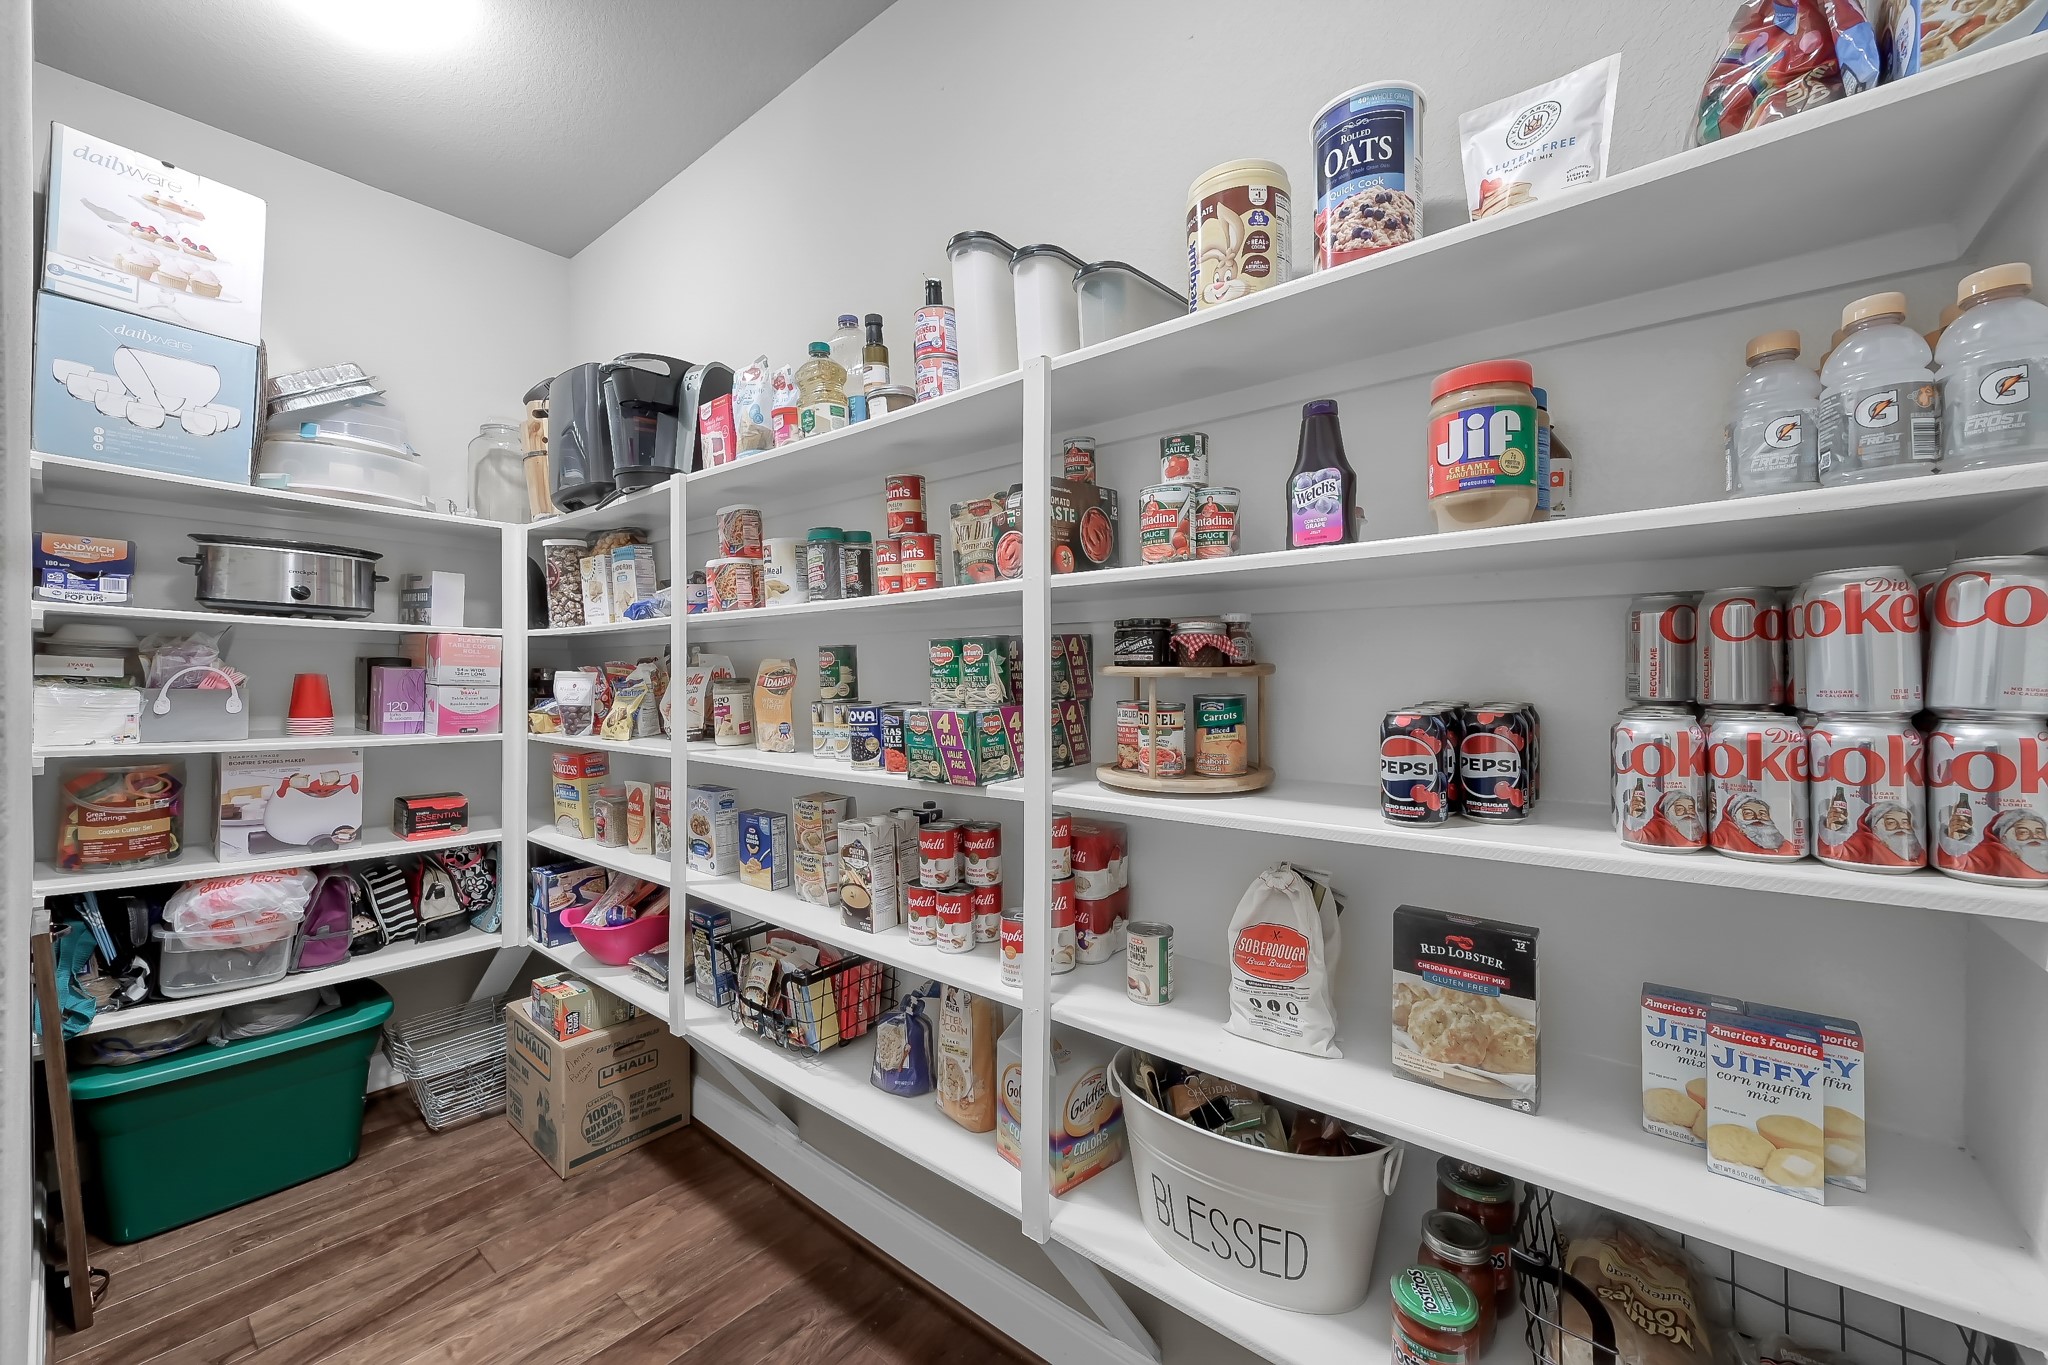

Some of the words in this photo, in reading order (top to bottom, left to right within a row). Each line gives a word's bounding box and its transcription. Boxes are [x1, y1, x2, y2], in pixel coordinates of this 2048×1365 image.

[1511, 114, 1527, 135] KING
[1530, 104, 1558, 114] ARTHUR
[1340, 129, 1371, 145] ROLLED
[1324, 136, 1393, 178] OATS
[1486, 136, 1576, 176] GLUTEN-FREE
[73, 146, 182, 193] dailyware
[1504, 157, 1536, 174] PANCAKE
[1329, 183, 1355, 200] Quick
[1358, 177, 1384, 189] Cook
[1189, 240, 1200, 314] Nesquik
[114, 325, 192, 351] dailyware
[1978, 363, 2030, 405] G
[1854, 389, 1899, 428] G
[1964, 412, 2032, 430] FROST
[1437, 410, 1521, 466] Jif
[1764, 414, 1802, 449] G
[1859, 432, 1904, 444] FROST
[1165, 446, 1190, 455] SAUCE
[1448, 462, 1490, 474] CREAMY
[1751, 453, 1799, 467] FROST
[1446, 470, 1468, 480] PEANUT
[1296, 481, 1336, 505] Welch's
[1112, 506, 1117, 516] 12
[955, 525, 973, 543] SUN
[1143, 530, 1165, 538] SAUCE
[53, 542, 114, 554] SANDWICH
[1934, 571, 2048, 628] Co
[1804, 584, 1919, 639] oke
[1009, 641, 1018, 659] 4
[1069, 637, 1079, 655] 4
[1649, 648, 1658, 659] ME
[1704, 646, 1710, 659] ME
[1073, 656, 1083, 666] CAN
[1649, 660, 1658, 697] RECYCLE
[387, 702, 408, 712] 120
[1066, 705, 1076, 723] 4
[937, 713, 950, 733] 4
[1010, 712, 1021, 731] 4
[1203, 712, 1237, 722] Carrots
[1070, 725, 1081, 735] CAN
[941, 735, 956, 747] CAN
[1075, 743, 1085, 751] PACK
[947, 751, 963, 759] VALUE
[1703, 732, 1809, 781] oke
[1808, 730, 1924, 787] Cok
[1927, 732, 2048, 794] Cok
[552, 759, 578, 775] Success
[951, 760, 966, 770] PACK
[1381, 760, 1433, 776] PEPSI
[1461, 757, 1517, 772] PEPSI
[416, 812, 461, 822] ESSENTIAL
[200, 878, 246, 896] Since
[1129, 943, 1147, 954] FRENCH
[1130, 951, 1145, 961] ONION
[1239, 937, 1306, 961] SOBERDOUGH
[1420, 943, 1445, 955] RED
[1448, 946, 1503, 970] LOBSTER
[1245, 958, 1266, 966] Brew
[1268, 958, 1292, 969] Bread
[1418, 962, 1447, 974] CHEDDAR
[1463, 971, 1489, 982] BISCUIT
[1492, 978, 1506, 986] MIX
[1432, 975, 1464, 987] GLUTEN
[1467, 984, 1489, 994] FREE
[1645, 998, 1694, 1016] America's
[516, 1026, 548, 1066] U-HAUL
[1650, 1039, 1681, 1053] corn
[1710, 1025, 1767, 1045] America's
[1769, 1038, 1819, 1057] Favorite
[602, 1055, 655, 1079] U-HAUL
[1677, 1053, 1706, 1068] mix
[629, 1089, 646, 1099] NEED
[1188, 1085, 1238, 1097] CHEDDAR
[1716, 1071, 1751, 1087] corn
[1756, 1078, 1812, 1101] muffin
[587, 1093, 612, 1108] U-HAUL
[629, 1097, 644, 1107] TAKE
[1747, 1089, 1780, 1105] mix
[587, 1101, 618, 1124] 100%
[585, 1109, 623, 1136] BUY-BACK
[586, 1118, 624, 1143] GUARANTEE
[606, 1130, 650, 1152] uhaul.com
[1073, 1128, 1108, 1156] COLORS
[1151, 1172, 1308, 1280] BLESSED
